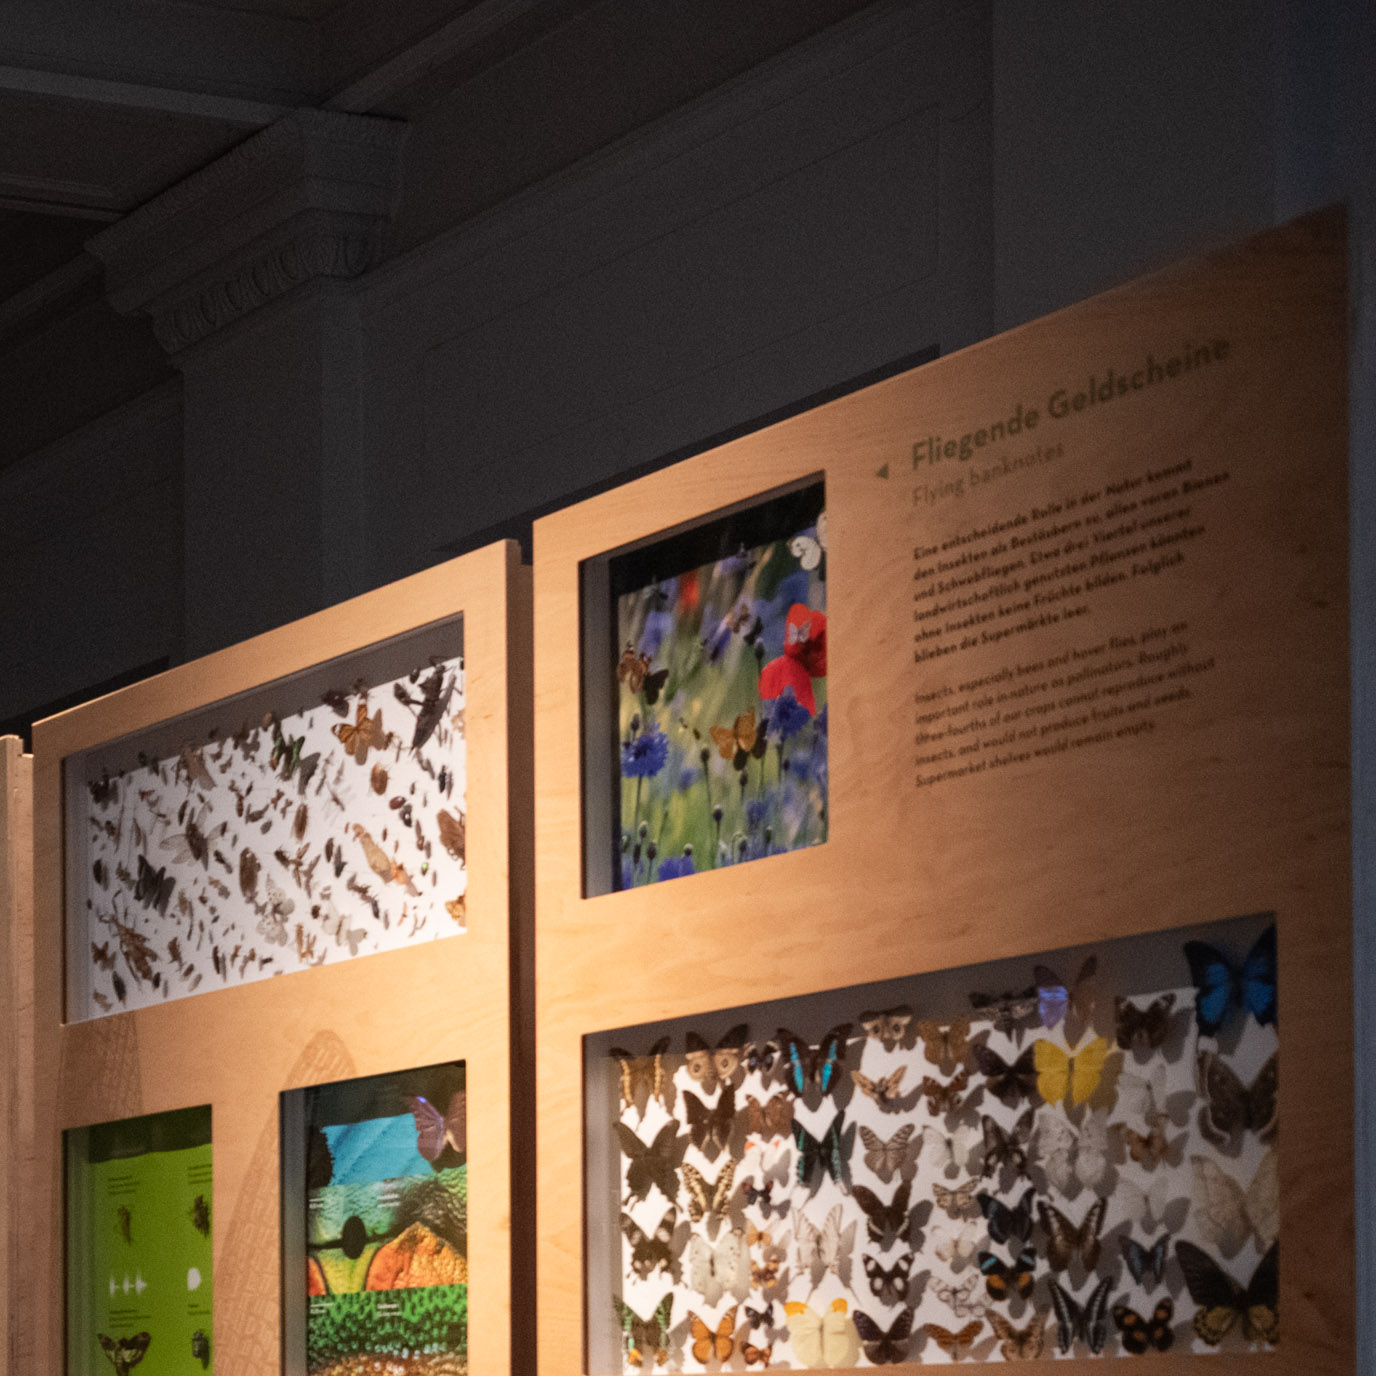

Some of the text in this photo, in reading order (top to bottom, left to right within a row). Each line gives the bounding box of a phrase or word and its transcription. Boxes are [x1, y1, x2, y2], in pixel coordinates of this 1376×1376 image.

[912, 339, 1231, 471] Fliegende Geldscheine
[912, 478, 965, 507] Flying
